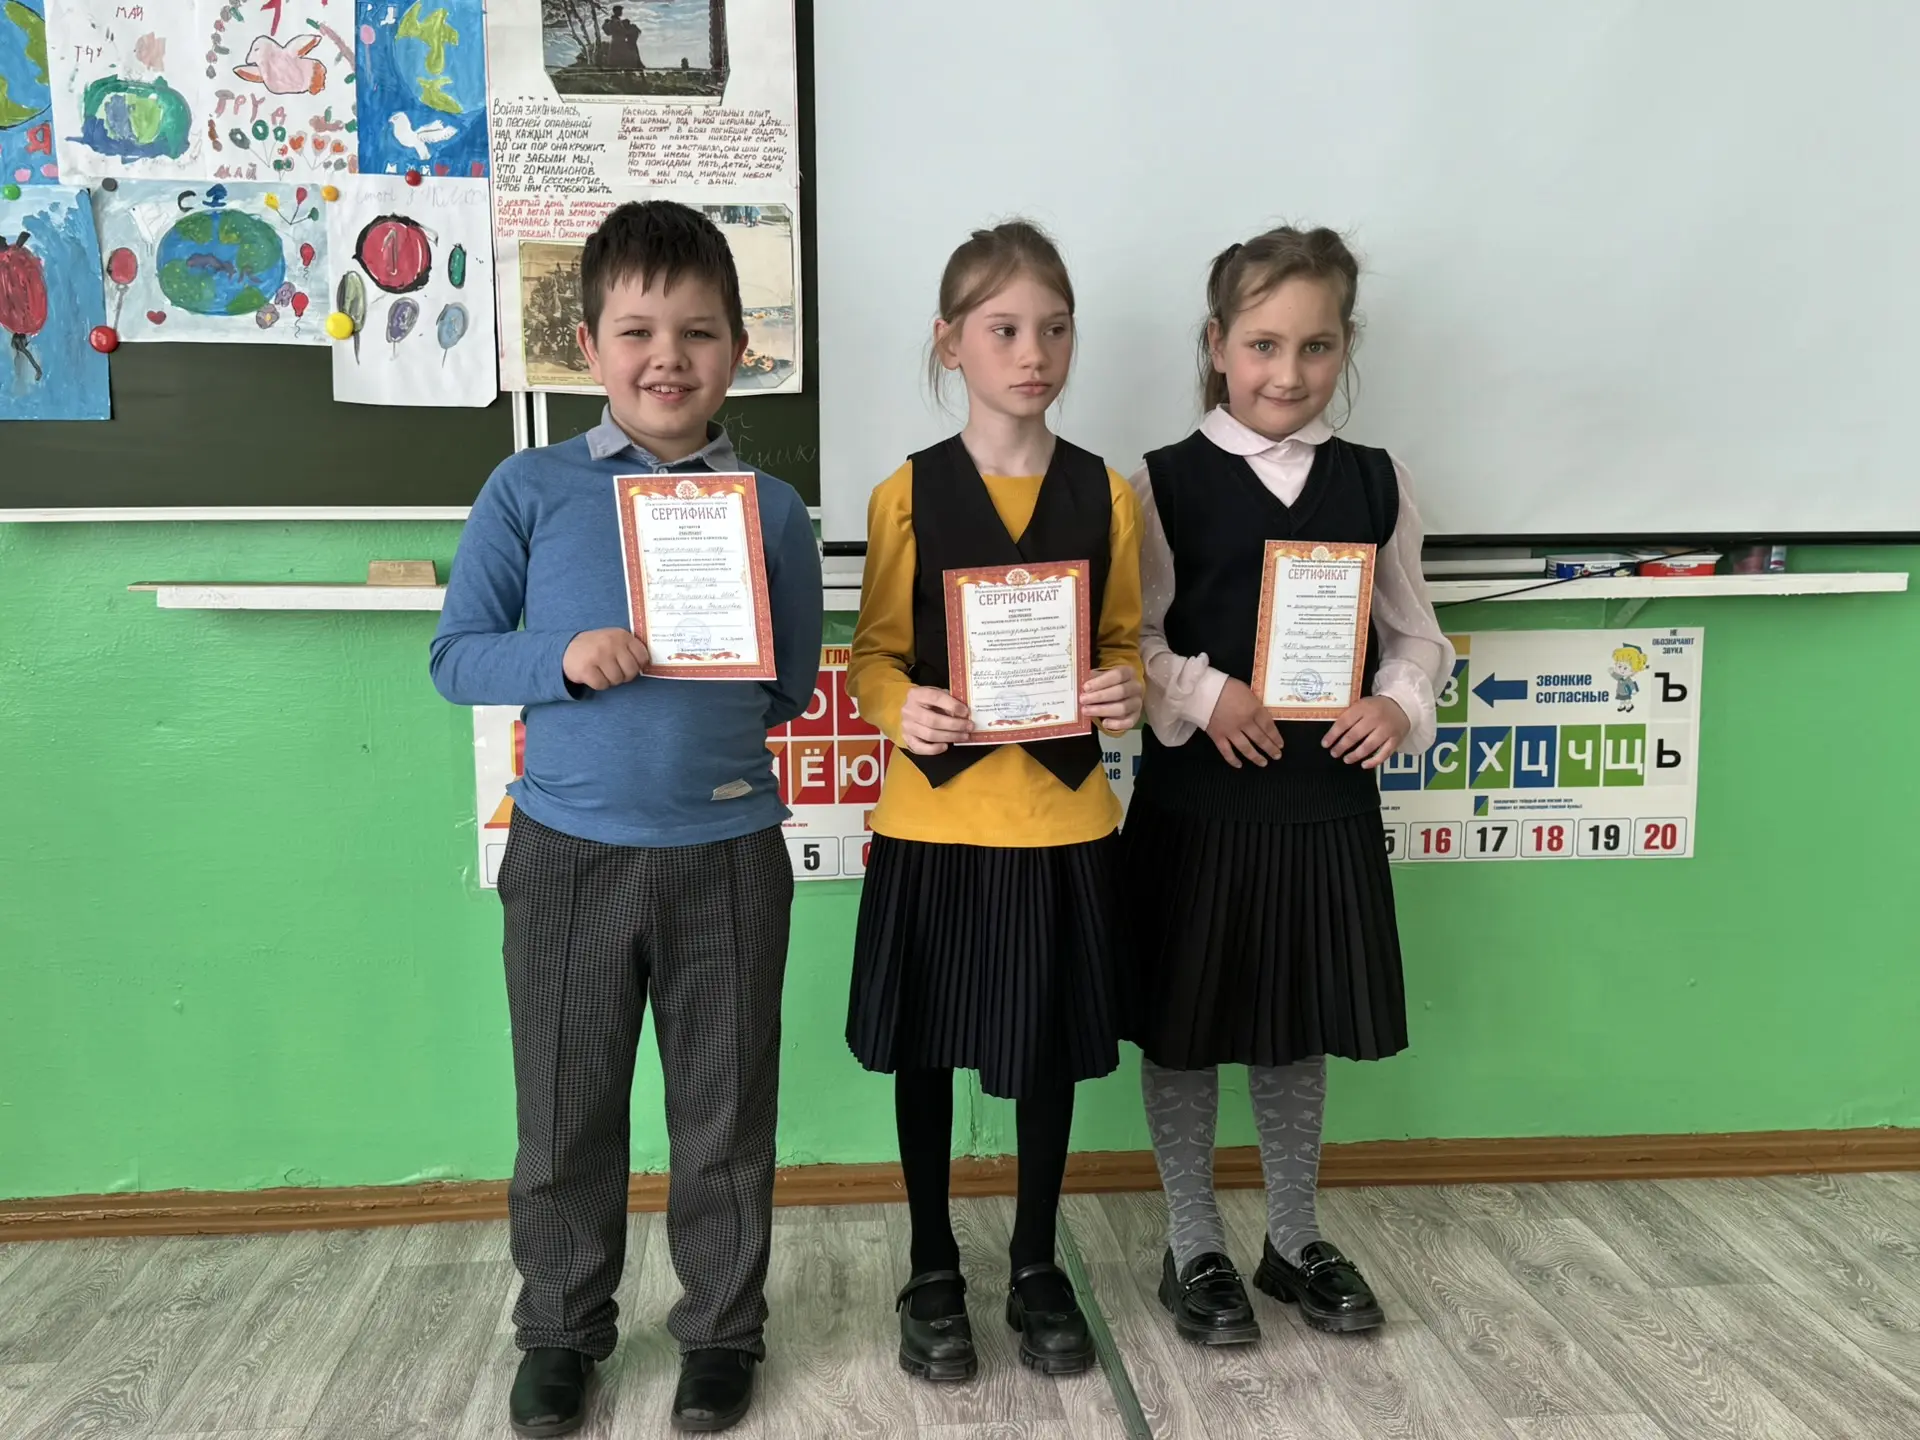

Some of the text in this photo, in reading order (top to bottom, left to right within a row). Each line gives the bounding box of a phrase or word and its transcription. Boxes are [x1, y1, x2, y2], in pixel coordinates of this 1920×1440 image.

[495, 129, 589, 140] НАД КАЖДЫМ ДОМОМ
[494, 141, 508, 152] ДО
[531, 142, 548, 150] ПОР
[495, 153, 504, 163] И
[525, 153, 567, 163] ЗАБЫЛИ
[572, 154, 594, 166] МЫ,
[496, 164, 516, 174] ЧТО
[527, 176, 534, 184] В
[496, 184, 520, 192] ЧТОБ
[544, 185, 551, 193] С
[553, 184, 586, 193] ТОБОЮ
[498, 208, 523, 217] КОГДА
[651, 506, 728, 521] СЕРТИФИКАТ
[1287, 567, 1350, 581] СЕРТИФИКАТ
[978, 588, 1060, 606] СЕРТИФИКАТ
[1669, 629, 1678, 637] НЕ
[1652, 637, 1695, 646] ОБОЗНАЧАЮТ
[1662, 646, 1683, 655] ЗВУКА
[1536, 673, 1592, 687] звонкие
[1654, 672, 1688, 703] Ъ
[1536, 690, 1610, 704] согласные
[1432, 742, 1459, 773] С
[1476, 741, 1504, 773] Х
[1521, 740, 1549, 778] Ц
[1567, 739, 1594, 771] Ч
[1605, 738, 1643, 777] Щ
[1656, 738, 1682, 769] Ь
[800, 748, 880, 788] Ё Ю
[1420, 827, 1452, 854] 16
[1476, 826, 1508, 852] 17
[1532, 825, 1564, 852] 18
[1588, 824, 1620, 851] 19
[1643, 823, 1677, 850] 20
[803, 844, 820, 871] 5
